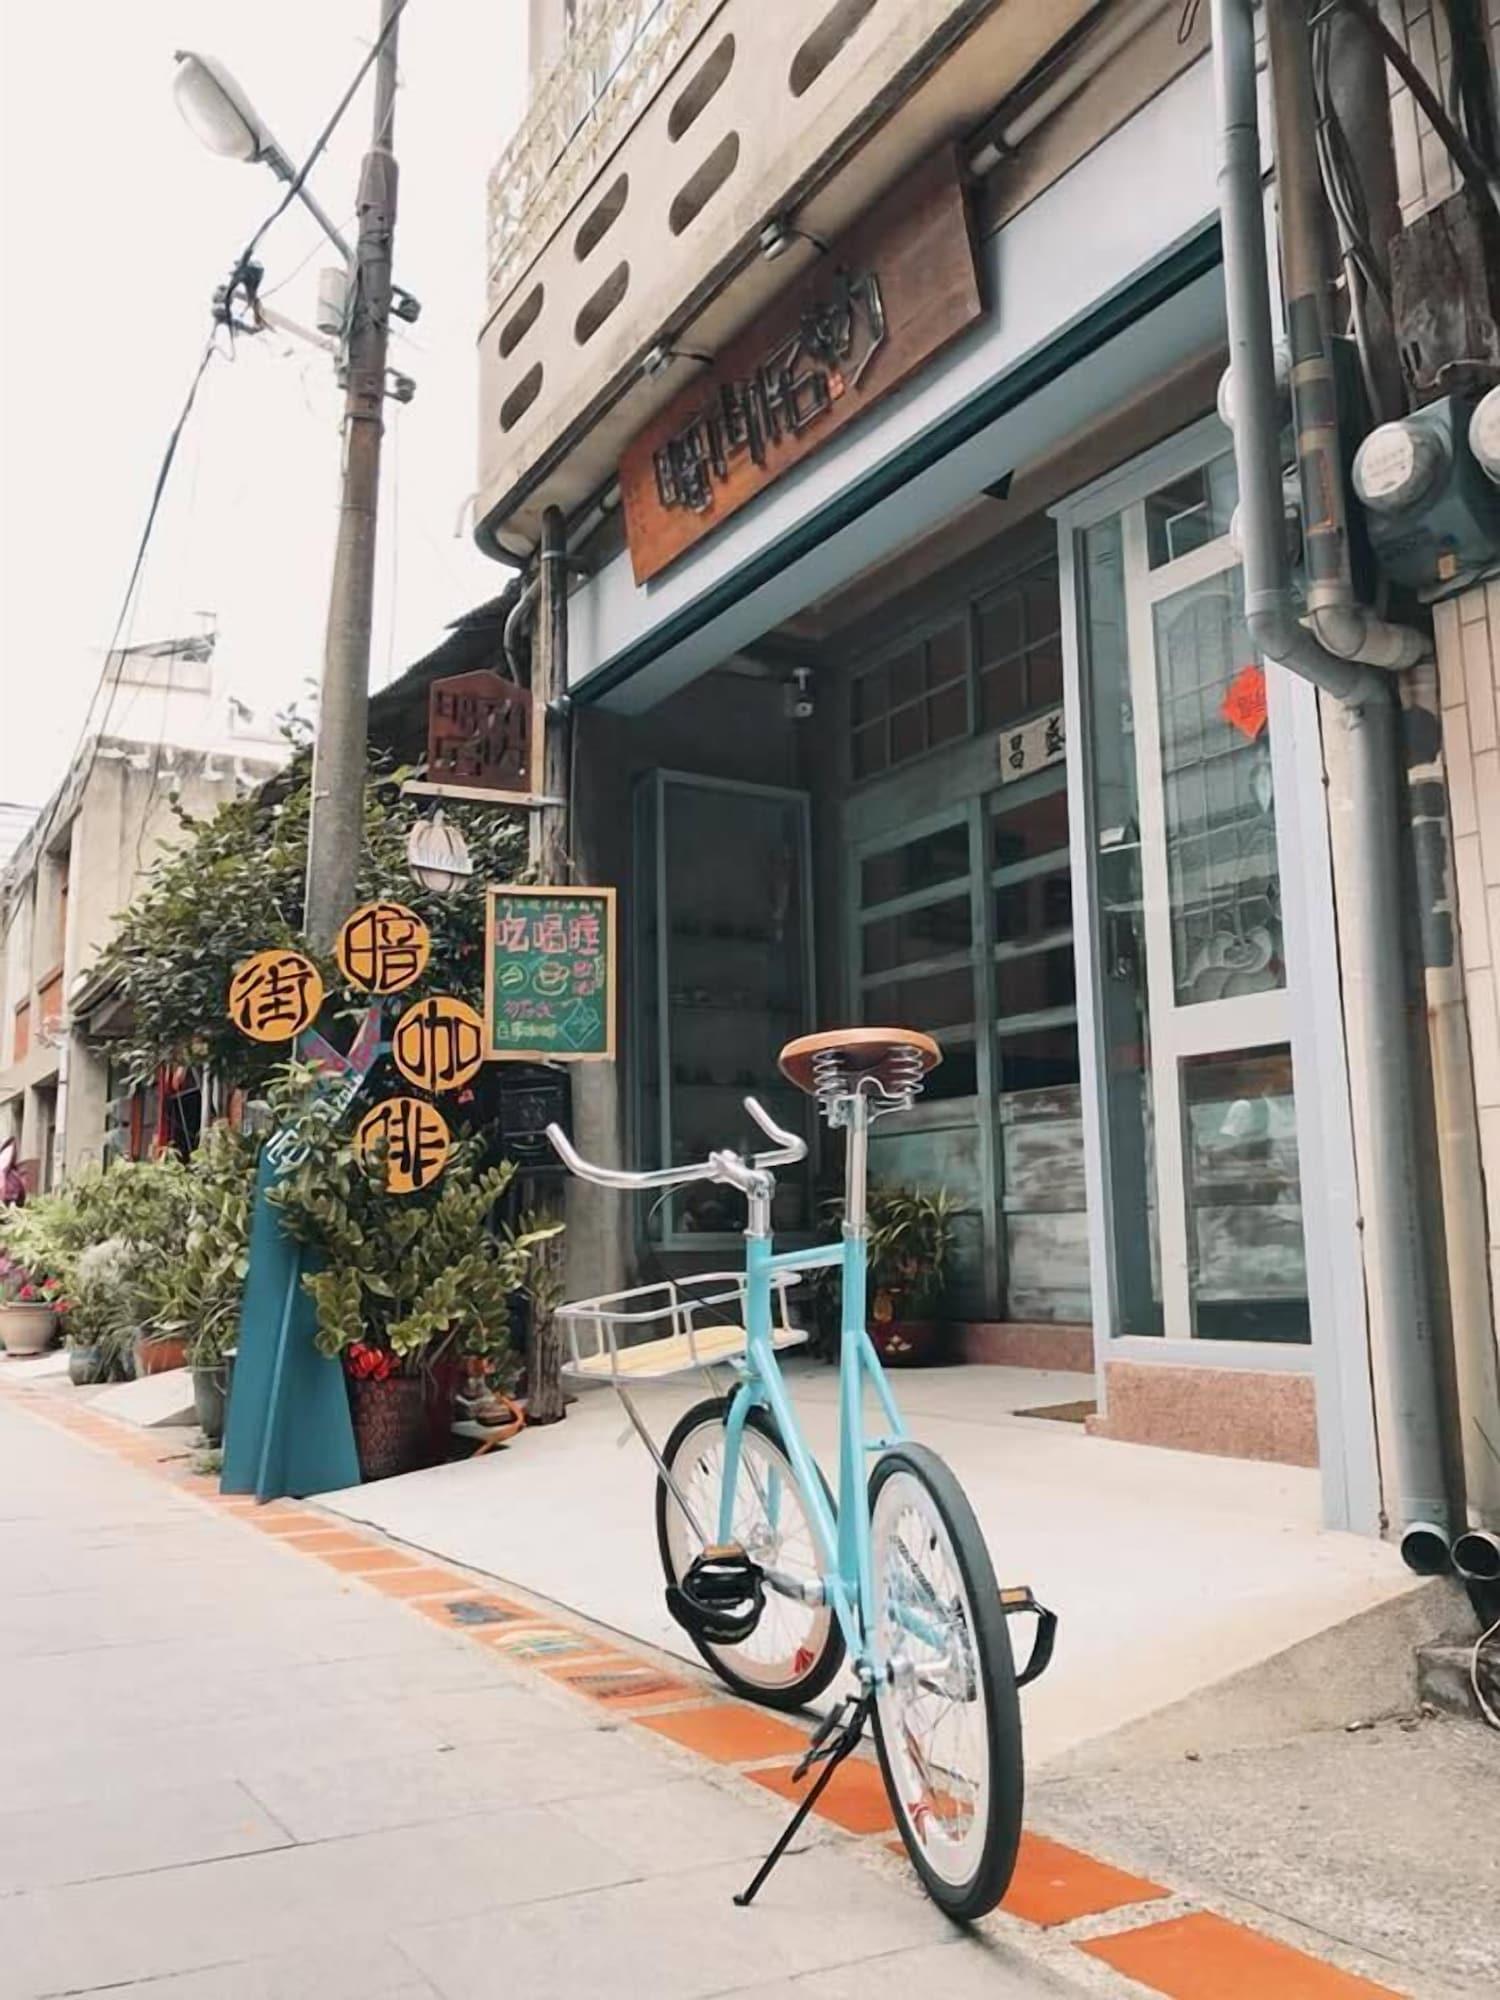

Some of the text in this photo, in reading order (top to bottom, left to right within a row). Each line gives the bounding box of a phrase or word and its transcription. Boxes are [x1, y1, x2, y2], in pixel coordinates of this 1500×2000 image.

[345, 905, 422, 990] 暗
[236, 957, 313, 1031] 街
[398, 1001, 481, 1086] 咖
